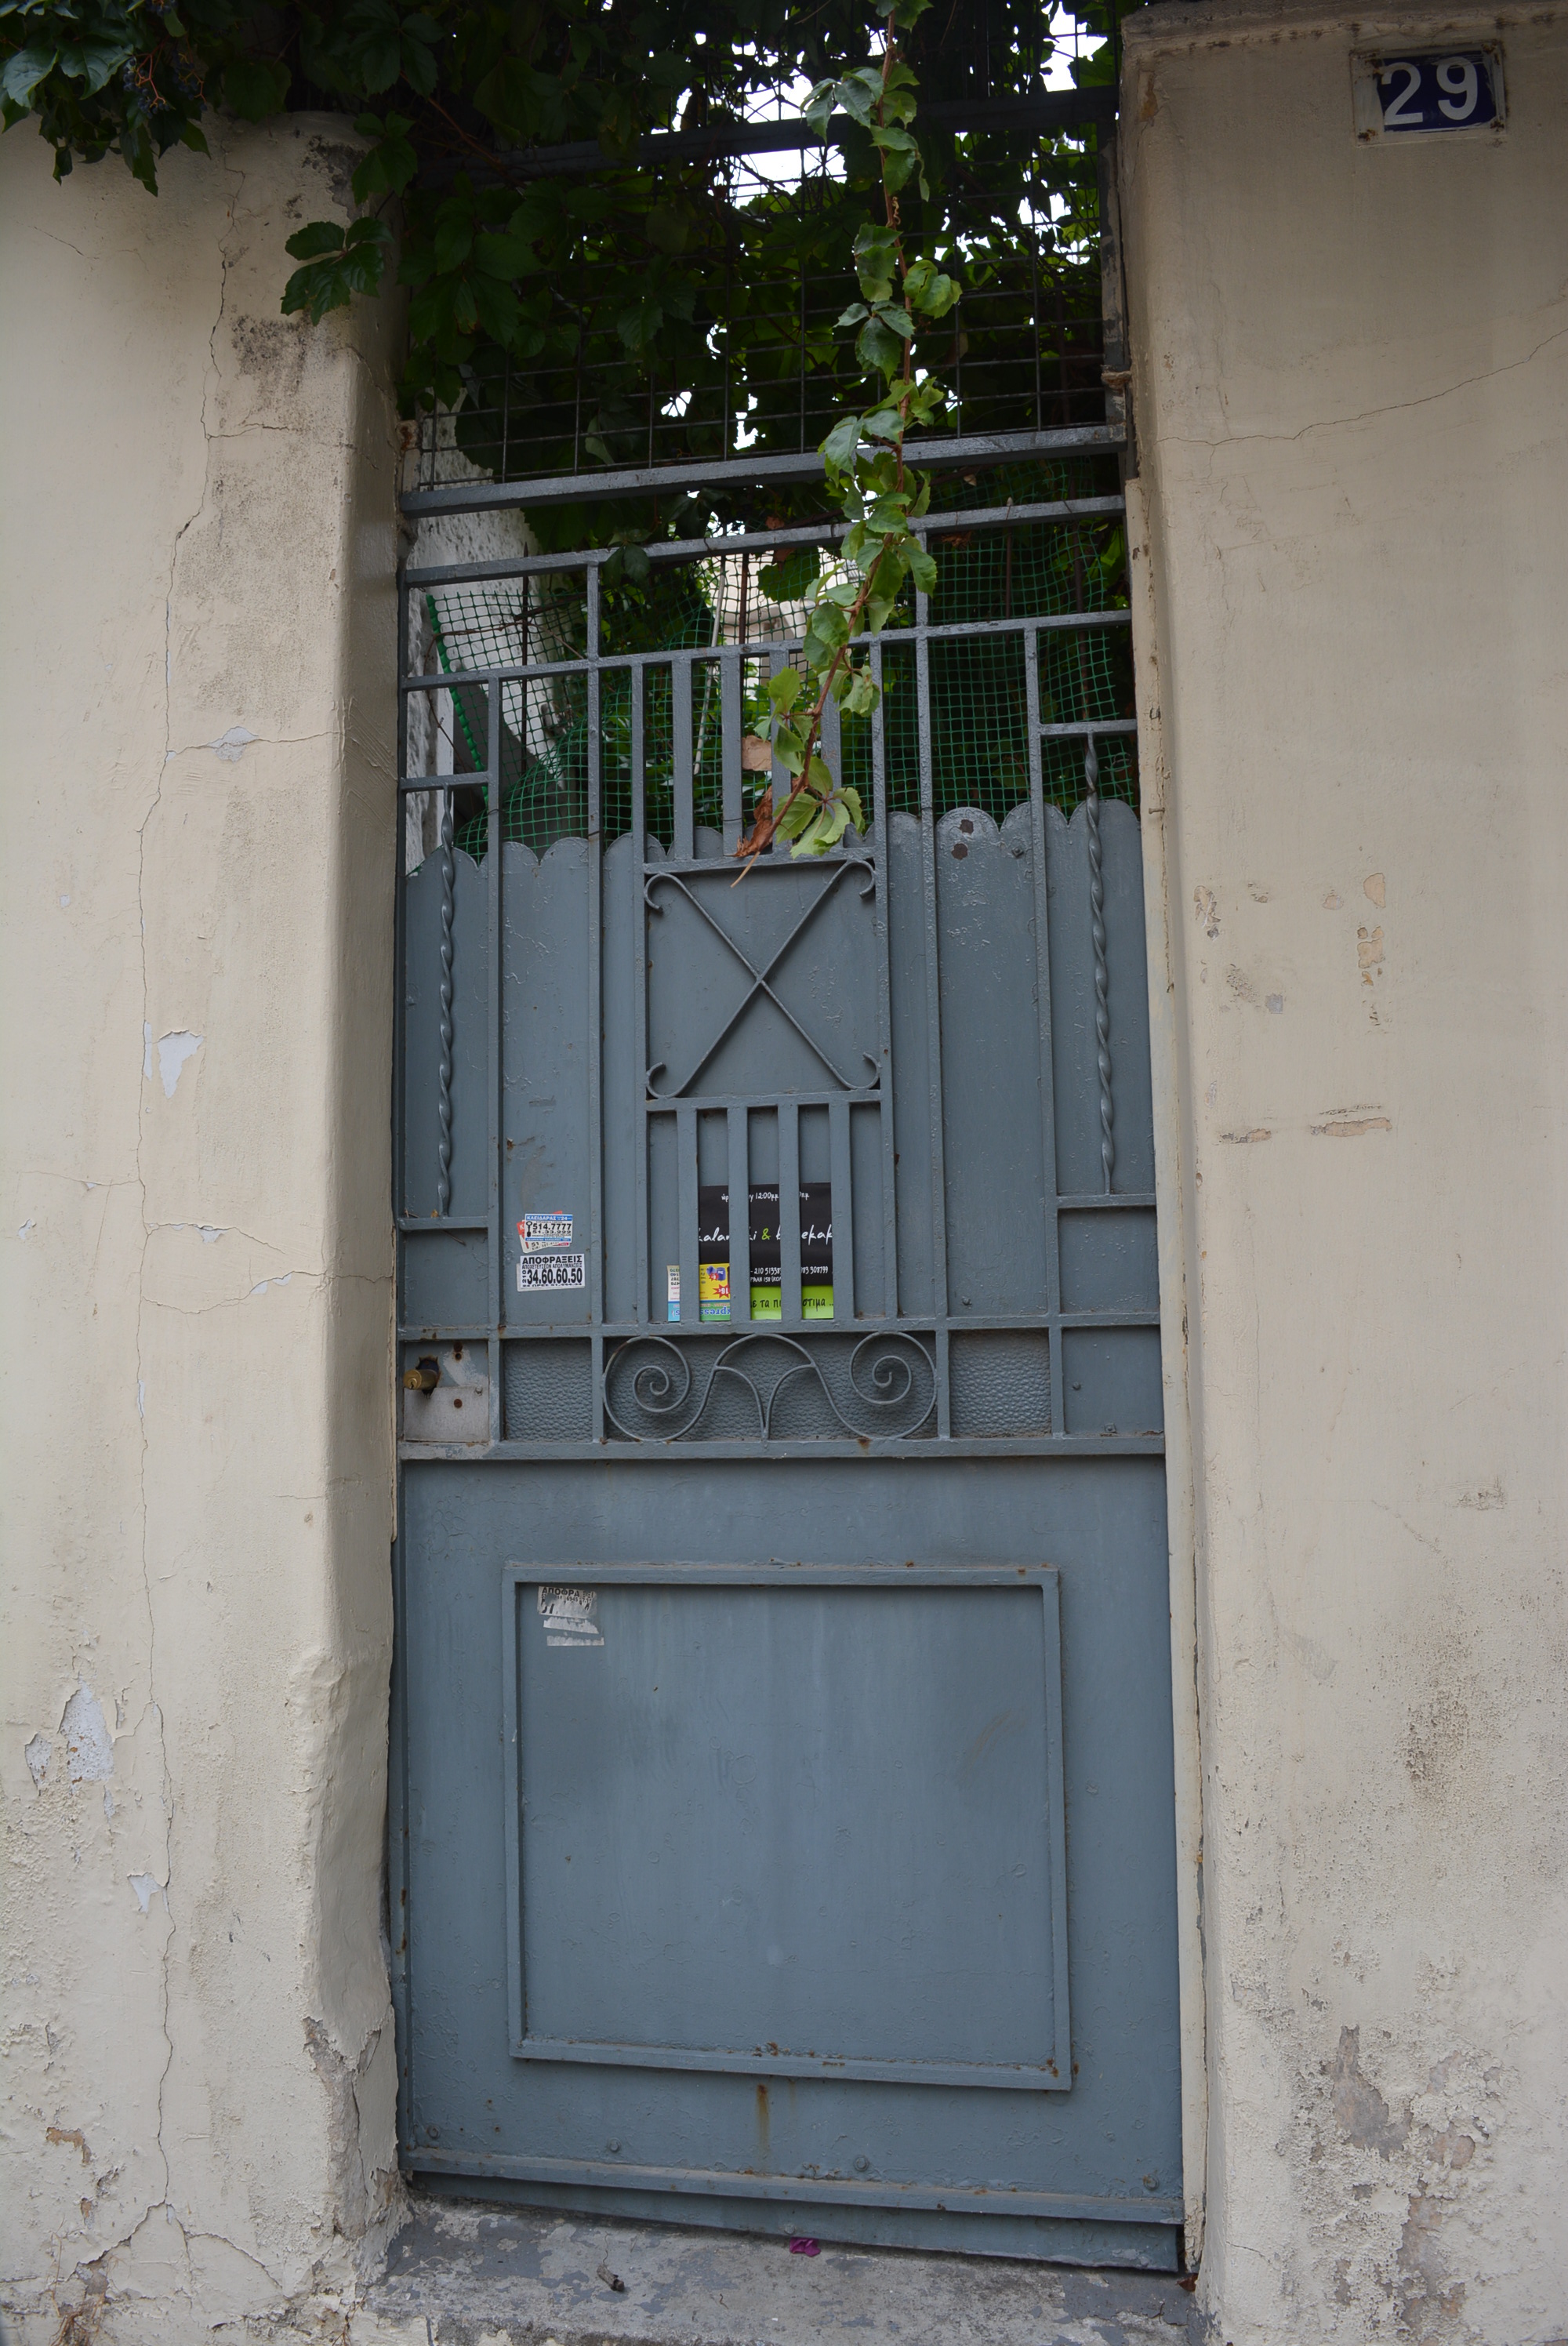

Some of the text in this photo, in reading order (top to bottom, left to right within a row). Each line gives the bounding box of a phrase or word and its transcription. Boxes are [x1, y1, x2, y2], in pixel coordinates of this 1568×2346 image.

[1381, 56, 1478, 125] 29
[761, 1227, 771, 1240] &
[522, 1255, 583, 1264] ΑΠΟΦΡΑΞΕΙΣ
[527, 1268, 583, 1284] 34.60.60.50
[699, 1306, 731, 1316] xpress
[760, 1299, 770, 1308] τα
[802, 1298, 826, 1312] στιμα
